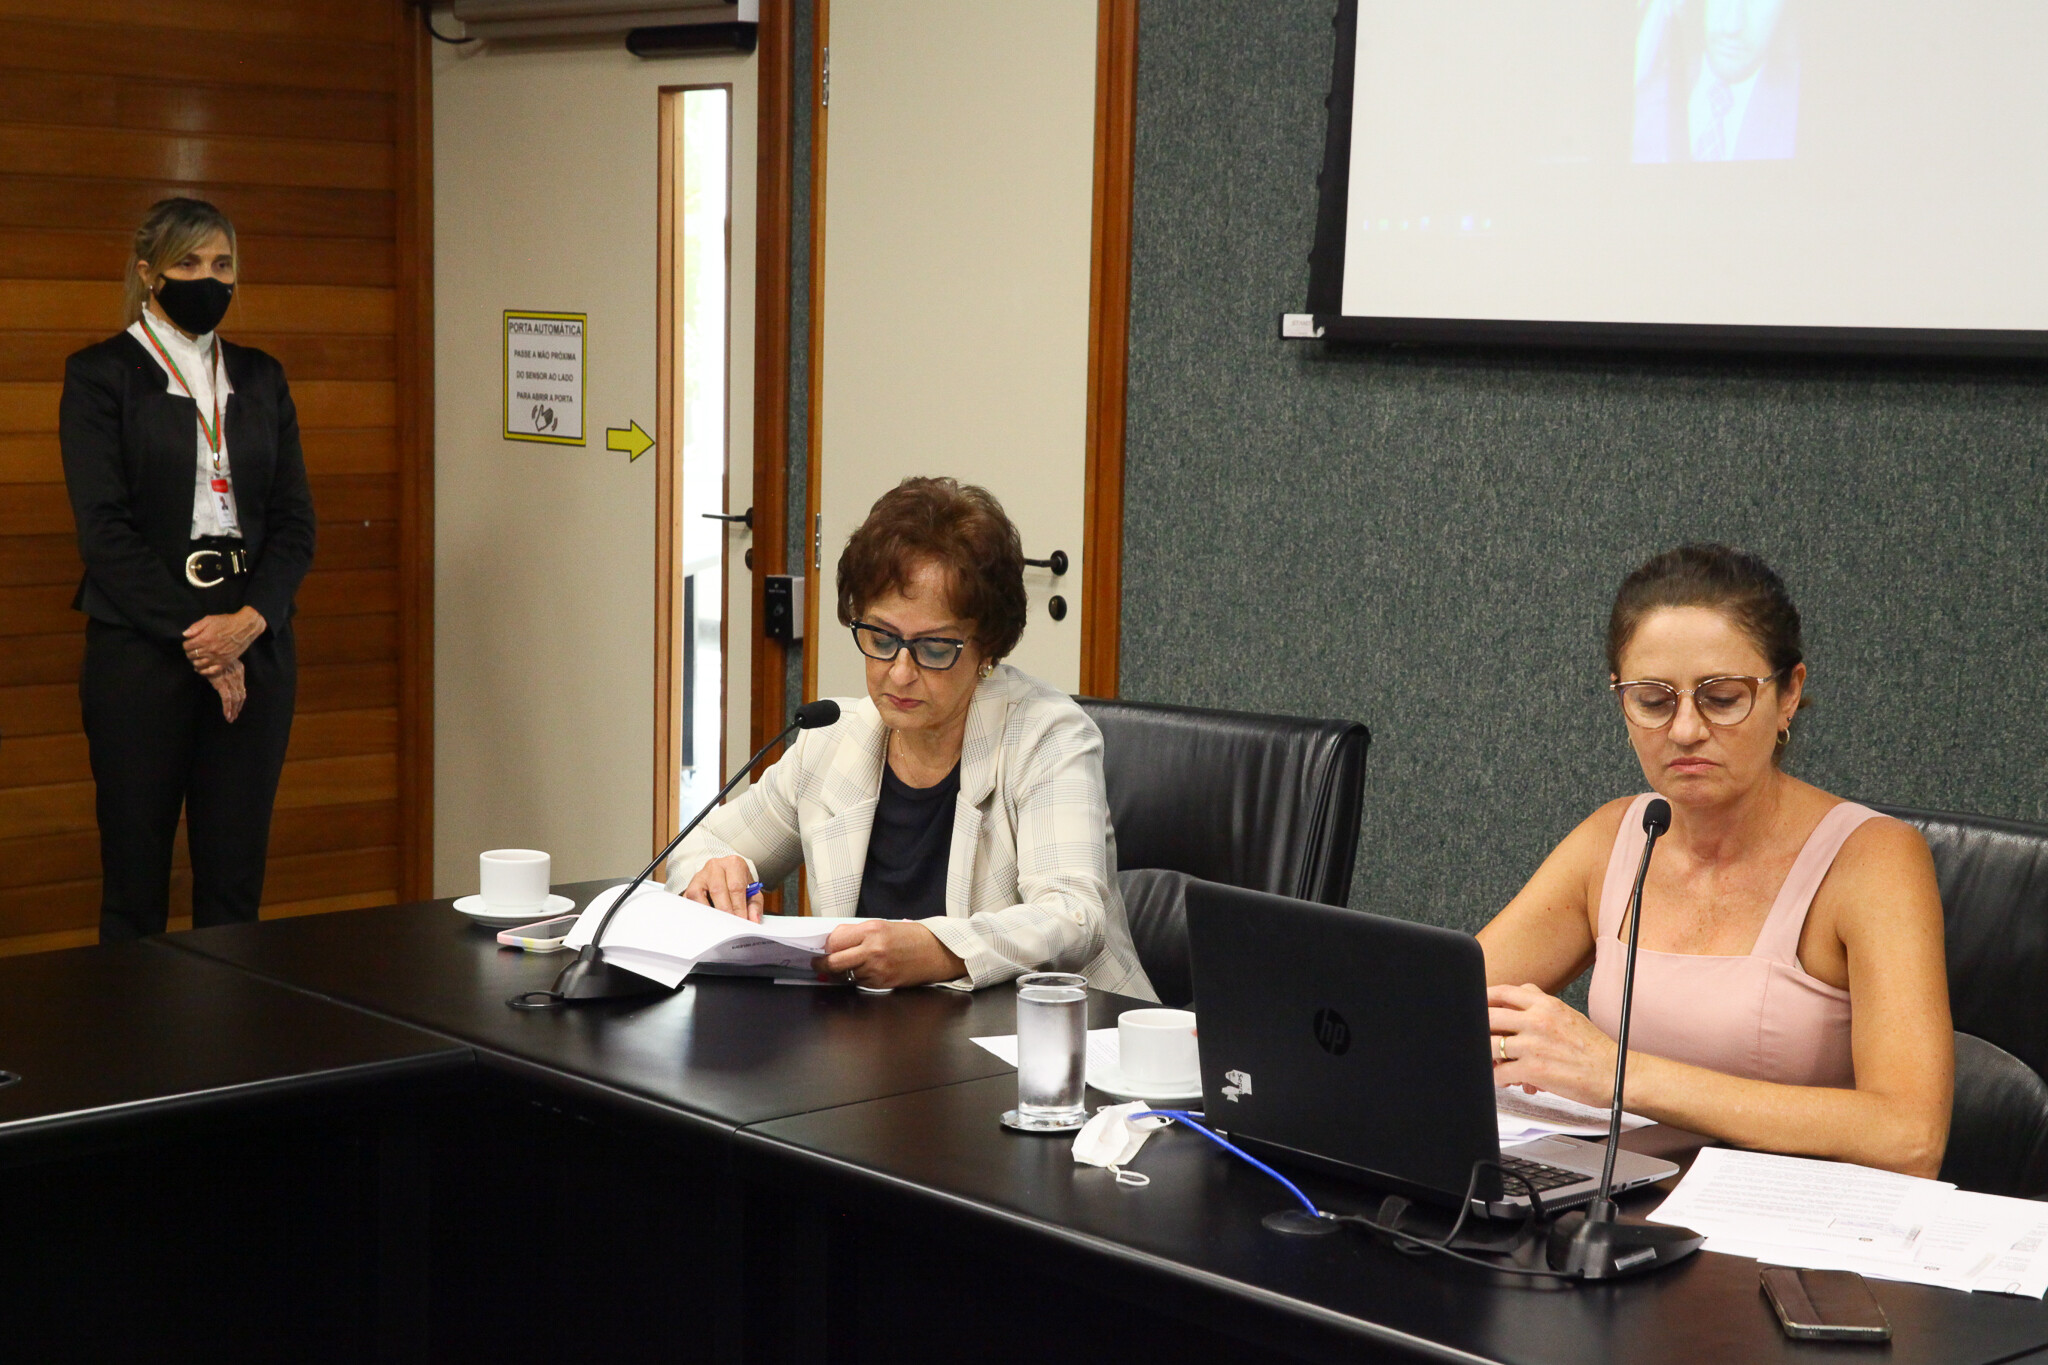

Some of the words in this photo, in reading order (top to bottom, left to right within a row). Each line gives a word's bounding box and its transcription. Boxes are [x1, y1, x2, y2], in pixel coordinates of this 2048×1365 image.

[509, 322, 533, 333] PORTA
[534, 323, 581, 335] AUTOMÁTICA
[514, 349, 531, 359] PASSE
[516, 371, 524, 379] DO
[526, 371, 548, 380] SENSOR
[549, 372, 557, 381] AO
[557, 373, 574, 382] LADO
[517, 392, 531, 400] PARA
[532, 392, 548, 401] ABRIR
[549, 394, 554, 402] A
[554, 394, 573, 403] PORTA
[1318, 1008, 1346, 1054] hp
